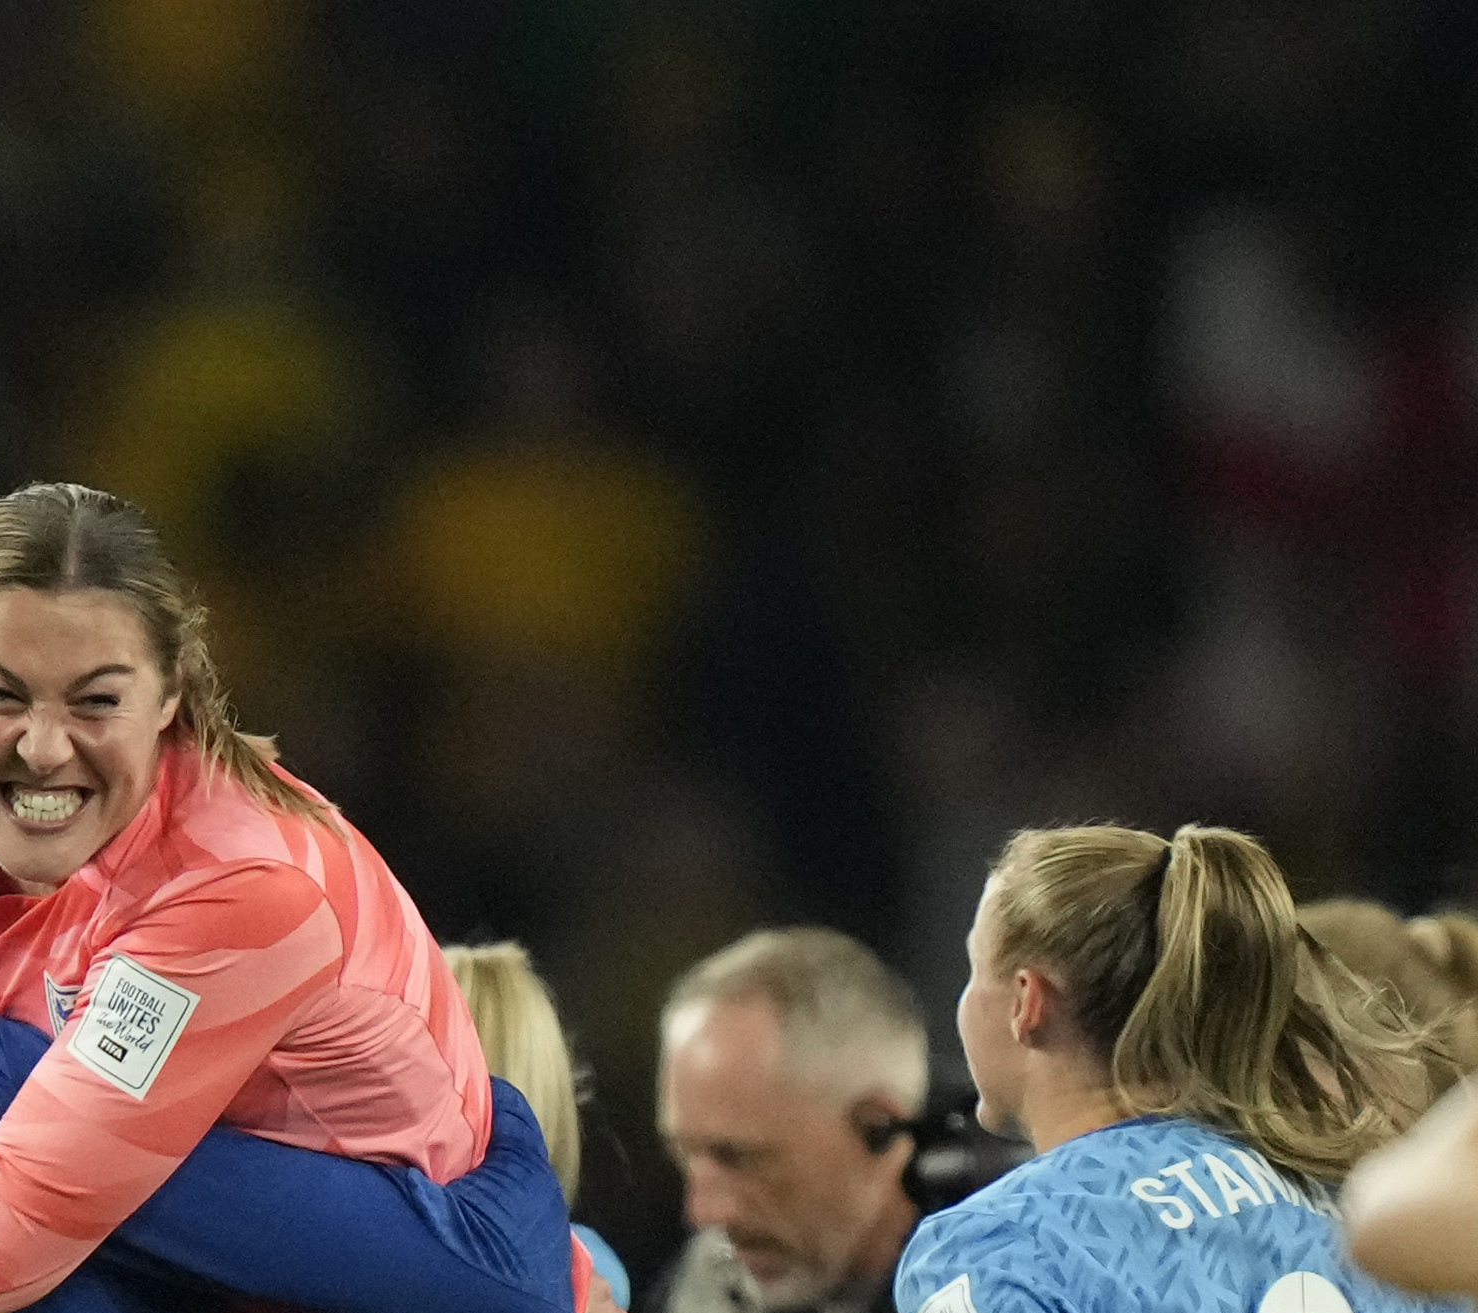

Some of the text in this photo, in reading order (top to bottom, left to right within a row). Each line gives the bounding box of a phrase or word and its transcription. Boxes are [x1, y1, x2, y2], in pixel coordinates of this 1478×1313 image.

[108, 992, 161, 1035] UNITES
[115, 977, 168, 1017] FOOTBALL
[99, 1036, 126, 1060] FIFA
[114, 1022, 155, 1053] World
[1130, 1147, 1302, 1230] STAN
